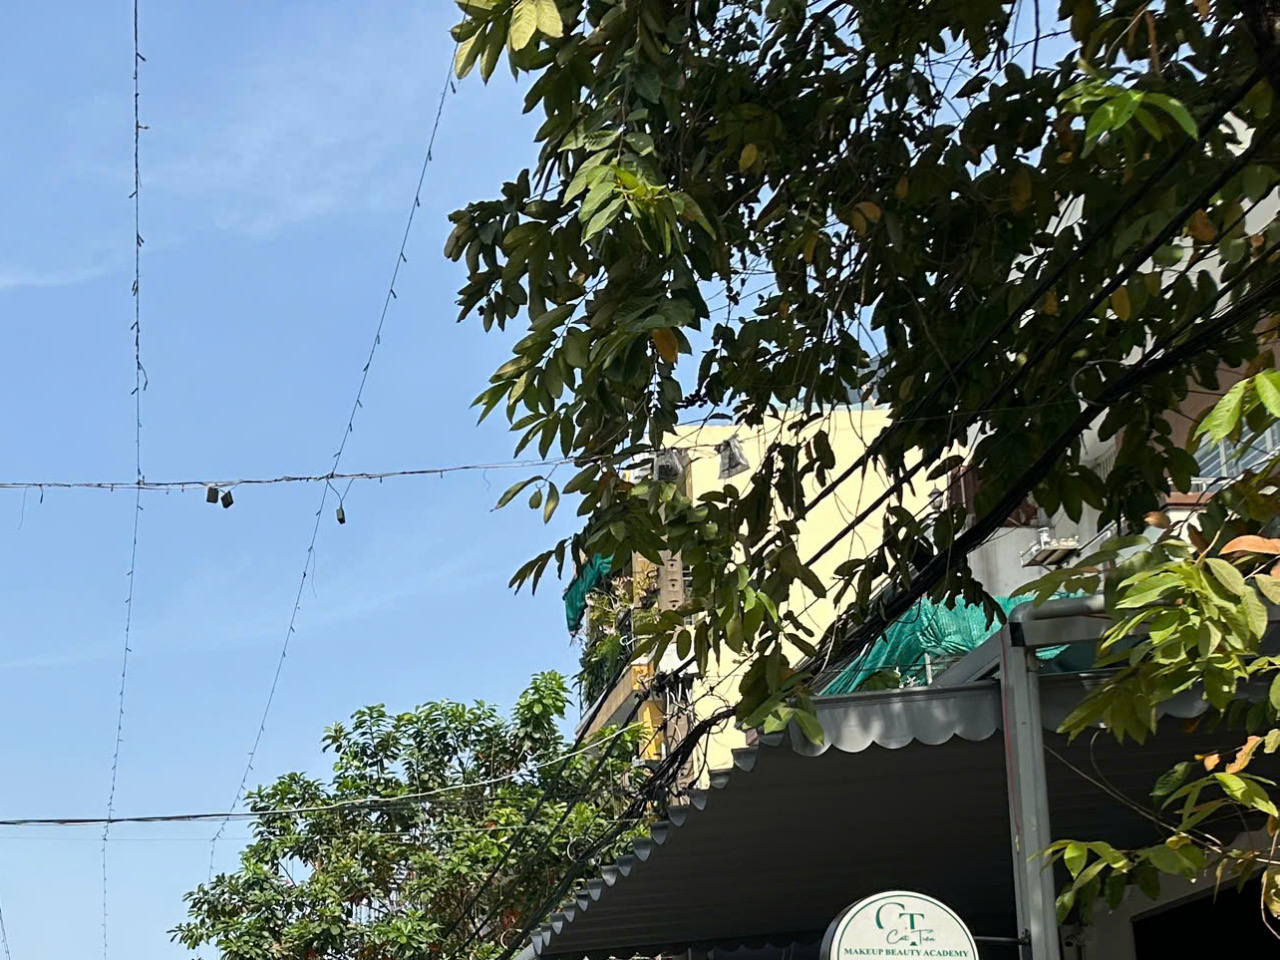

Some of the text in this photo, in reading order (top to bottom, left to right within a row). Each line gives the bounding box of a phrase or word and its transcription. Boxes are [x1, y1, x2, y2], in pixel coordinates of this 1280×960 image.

[844, 948, 969, 957] MAKEUP BEAUTY ACADEMY
